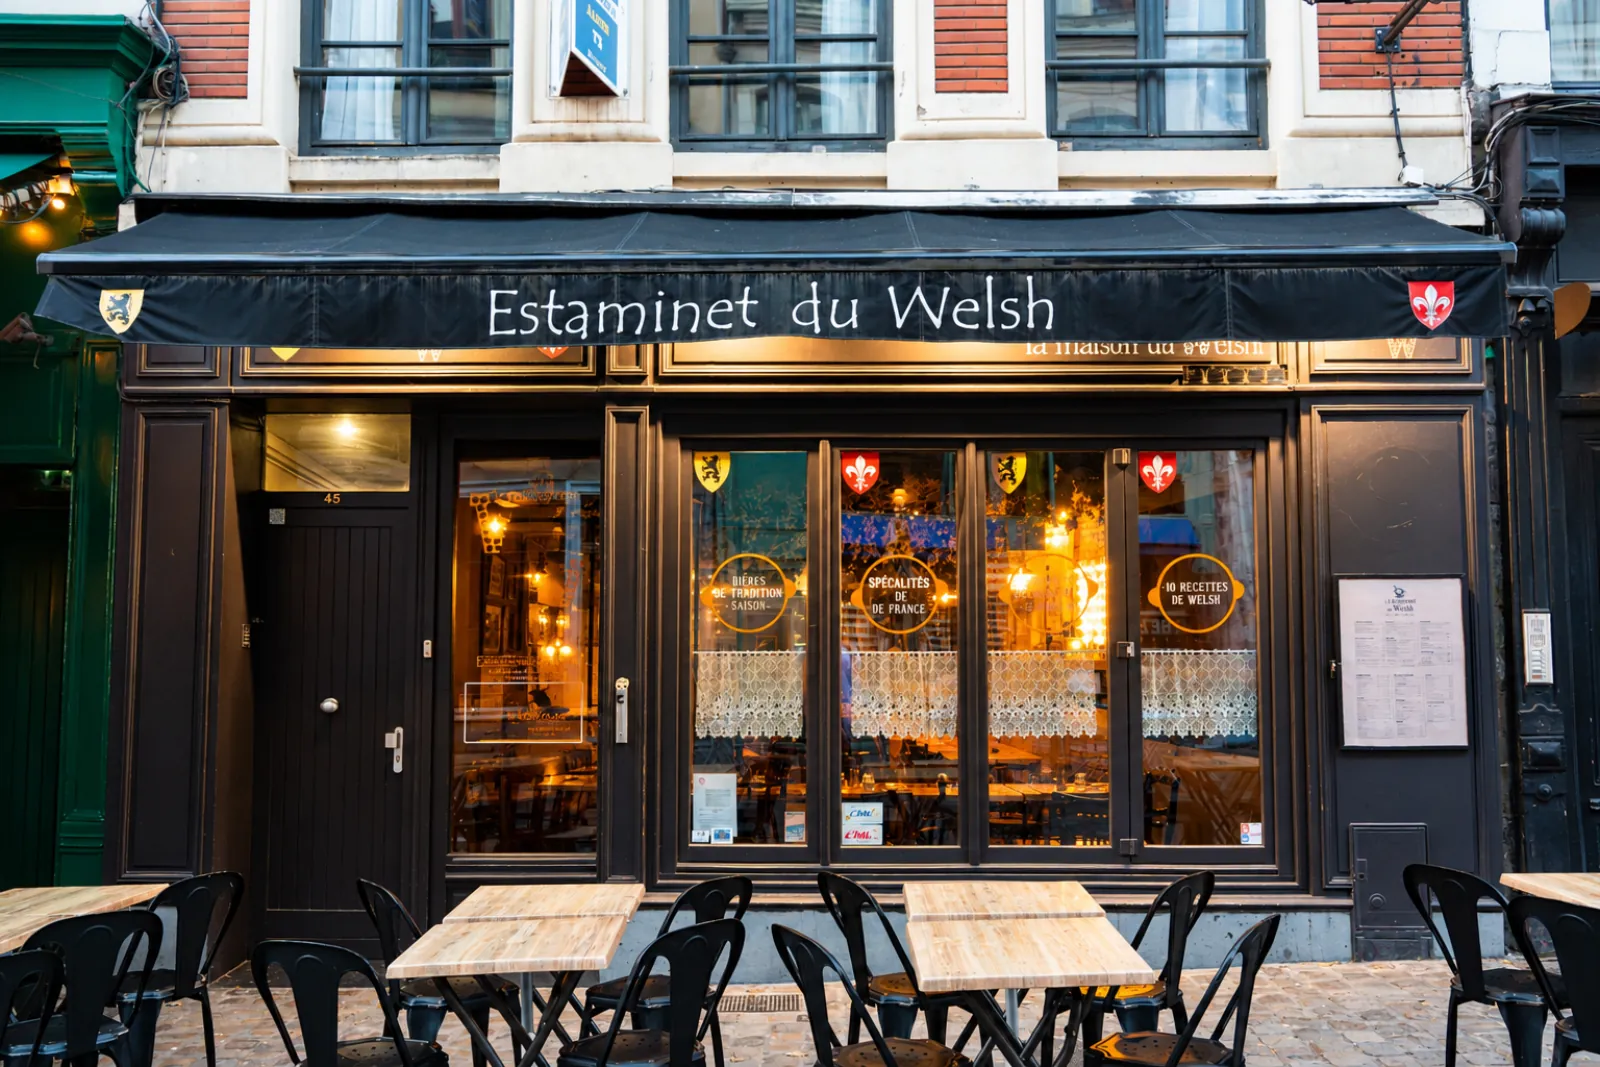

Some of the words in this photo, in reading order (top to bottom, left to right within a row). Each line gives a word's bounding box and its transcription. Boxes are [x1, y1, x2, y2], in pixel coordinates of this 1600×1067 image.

[489, 286, 759, 340] Estaminet
[792, 281, 858, 334] du
[888, 275, 1054, 330] Welsh
[323, 493, 341, 504] 45
[731, 587, 782, 599] TRADITION
[1179, 581, 1229, 593] RECETTES
[895, 590, 908, 602] DE
[1171, 594, 1184, 605] DE
[1187, 594, 1221, 605] WELSH
[872, 603, 885, 615] DE
